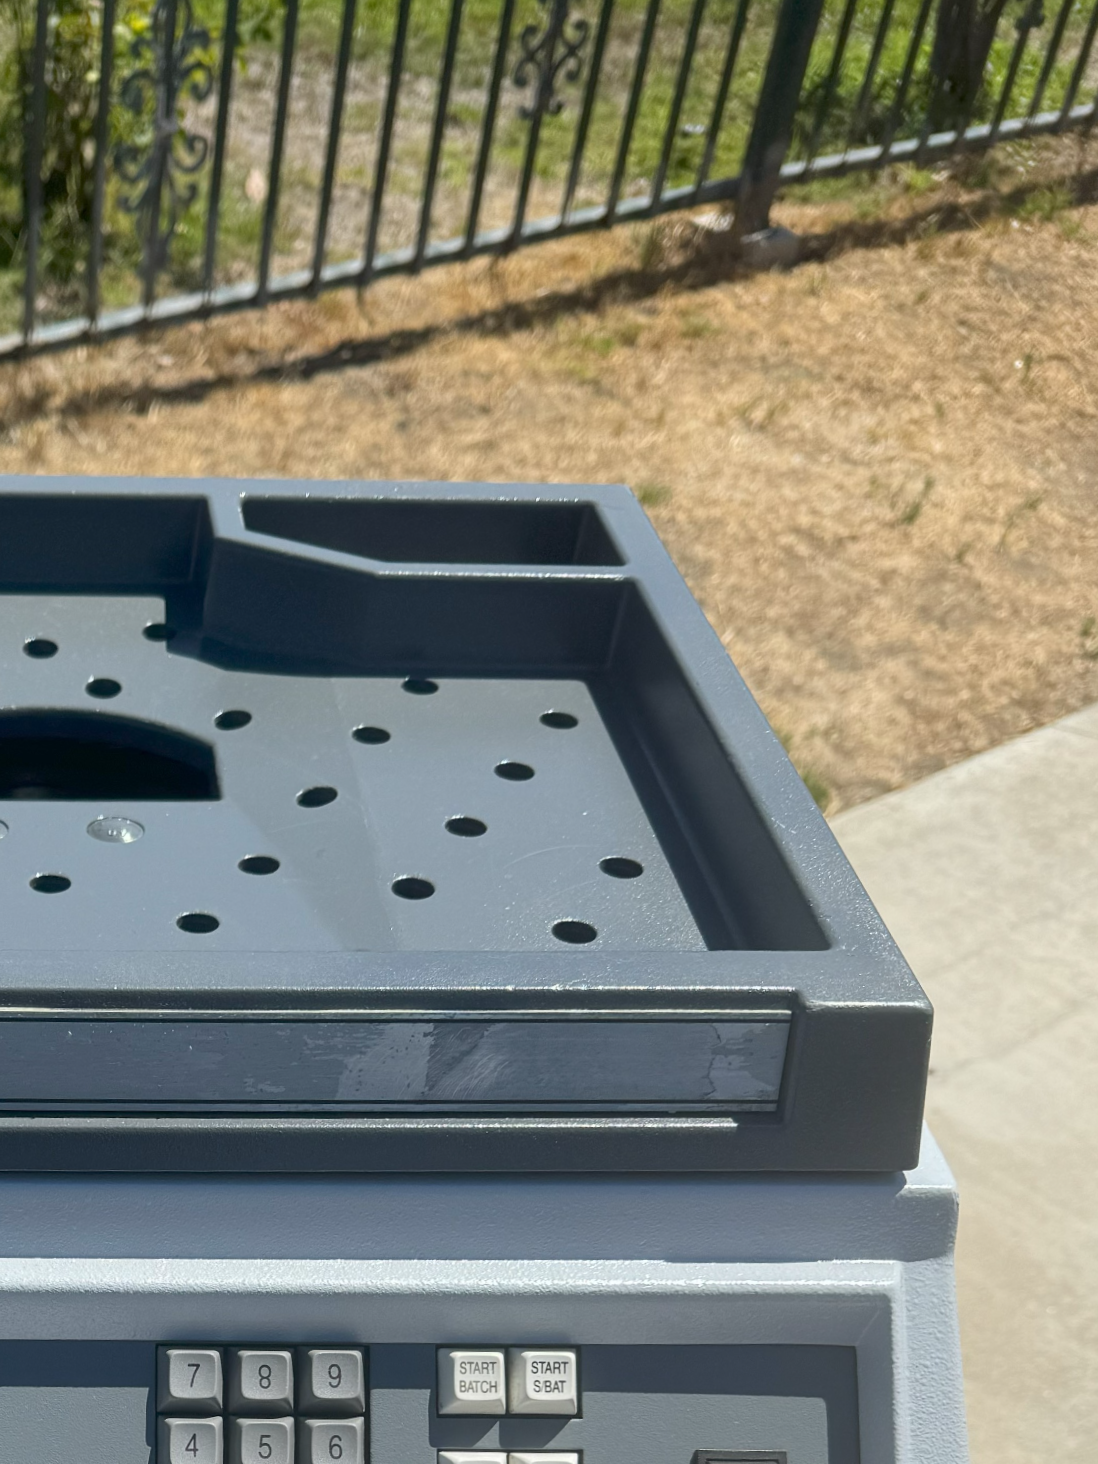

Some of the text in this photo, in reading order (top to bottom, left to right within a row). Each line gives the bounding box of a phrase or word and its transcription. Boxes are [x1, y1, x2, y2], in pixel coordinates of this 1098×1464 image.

[187, 1363, 201, 1388] 7
[258, 1364, 272, 1390] 8
[327, 1363, 342, 1389] 9
[459, 1361, 498, 1375] START
[531, 1361, 569, 1375] START
[459, 1379, 498, 1394] BATCH
[533, 1379, 567, 1394] S/BAT
[184, 1432, 199, 1458] 4
[258, 1434, 272, 1460] 5
[328, 1434, 343, 1460] 6
